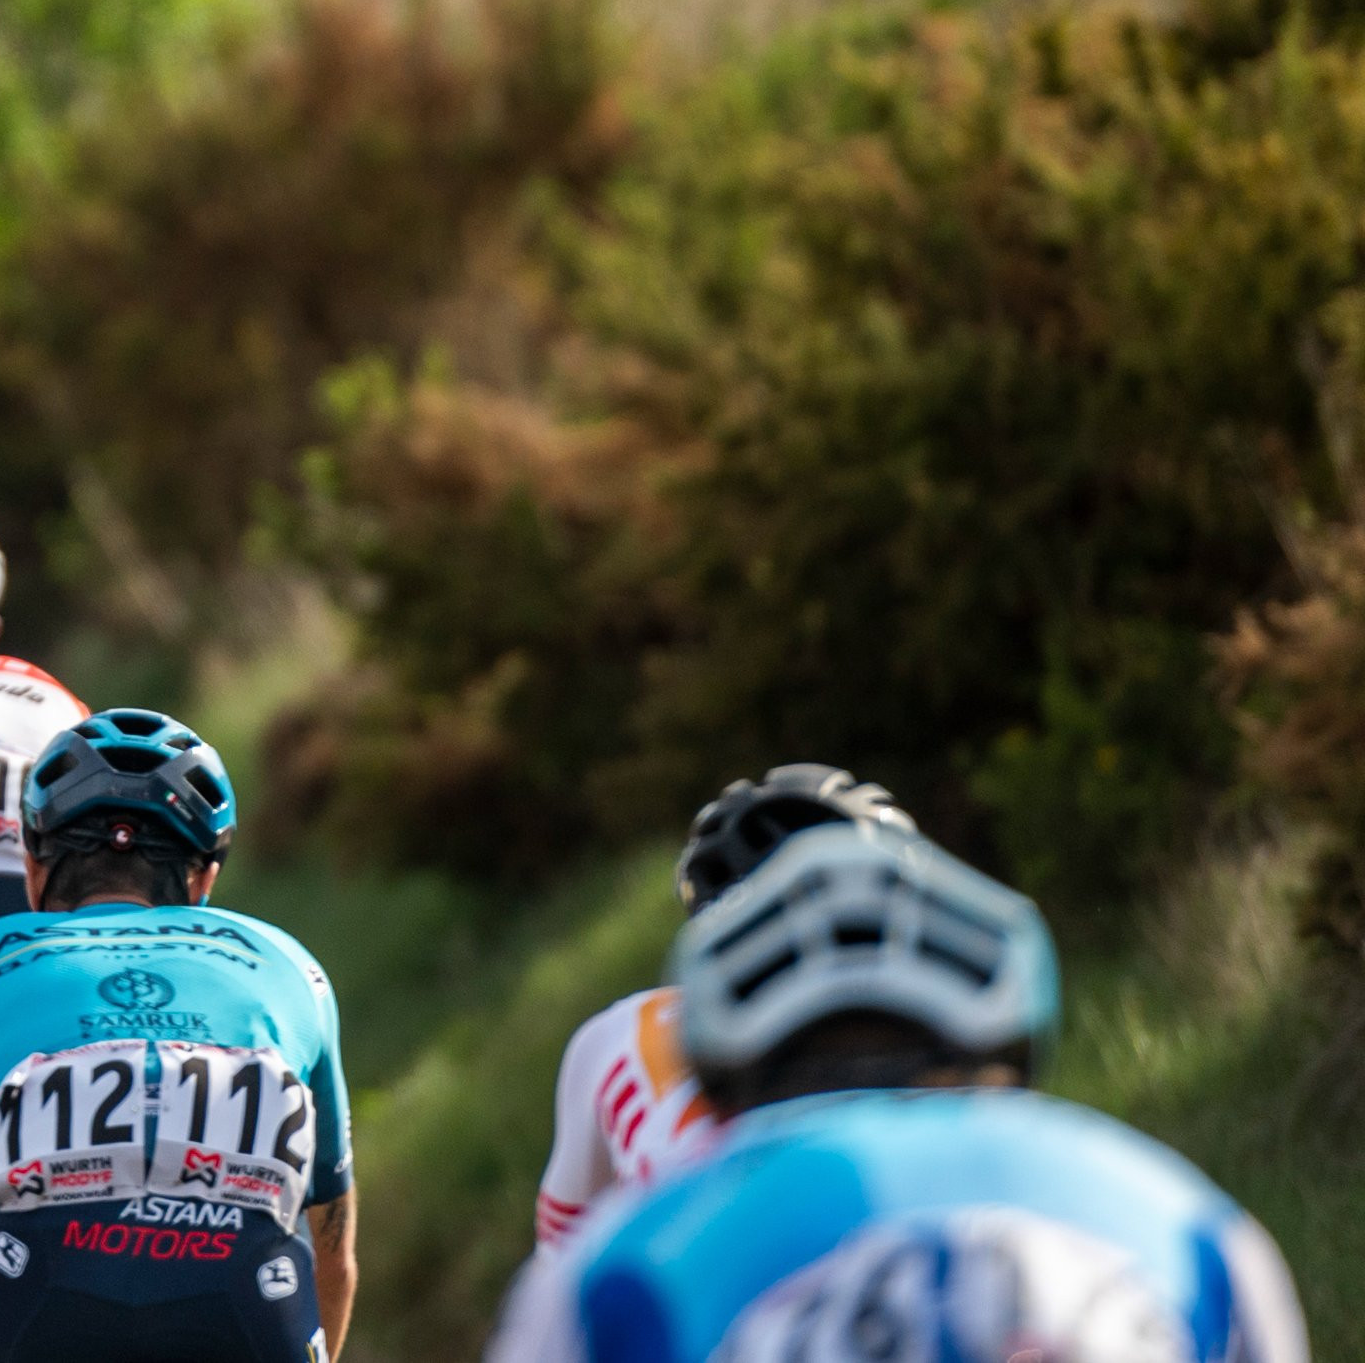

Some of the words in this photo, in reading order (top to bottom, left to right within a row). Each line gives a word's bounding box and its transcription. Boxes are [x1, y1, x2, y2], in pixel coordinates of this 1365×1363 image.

[79, 1012, 208, 1029] SAMRUK
[178, 1056, 307, 1174] 112
[49, 1156, 112, 1174] WURTH
[118, 1196, 244, 1230] ASTANA
[62, 1219, 238, 1261] MOTORS
